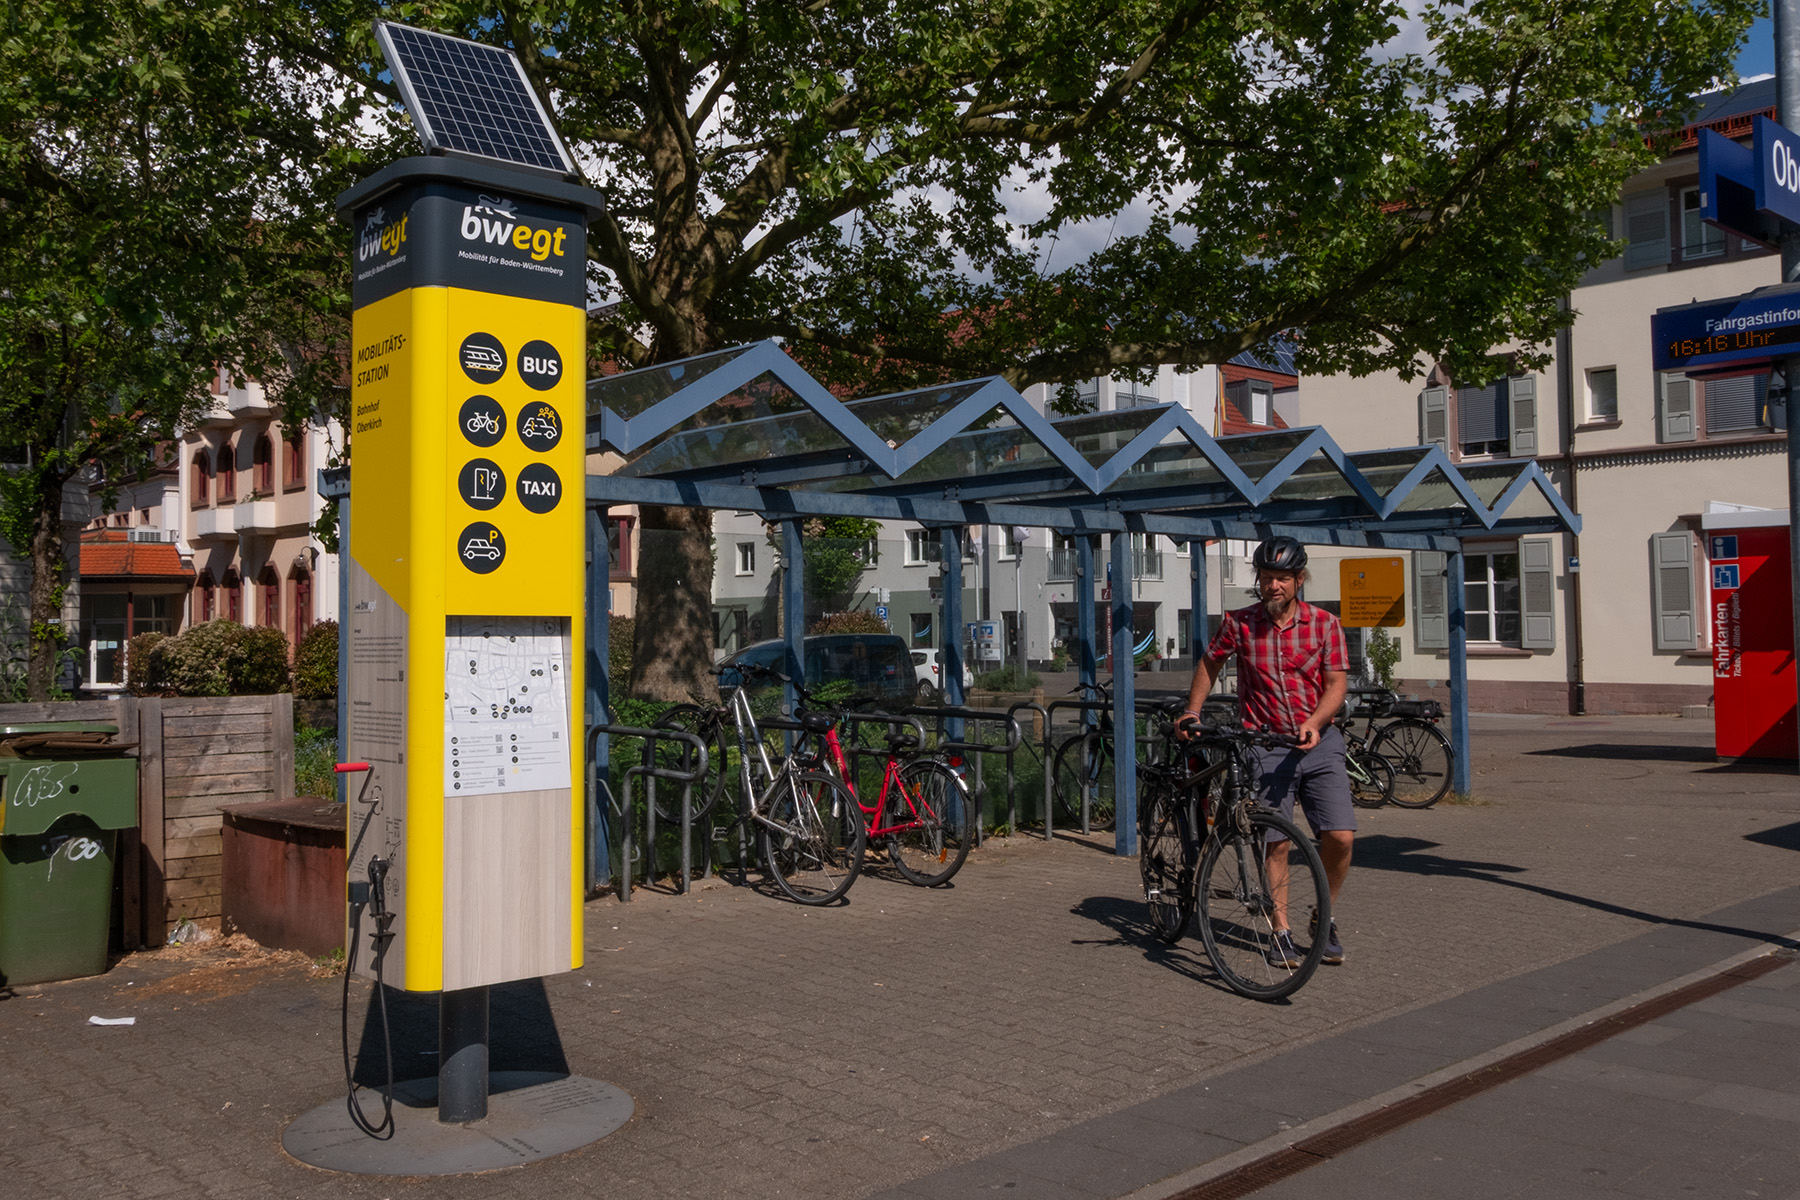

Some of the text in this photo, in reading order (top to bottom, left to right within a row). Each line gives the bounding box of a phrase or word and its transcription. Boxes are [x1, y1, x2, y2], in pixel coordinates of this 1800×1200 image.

[1773, 139, 1800, 193] Ob
[360, 211, 408, 262] bwegt
[461, 206, 567, 261] bwegt
[458, 250, 564, 276] Mobilität für Baden-Württemberg
[357, 334, 406, 364] MOBILITÄTS-
[1670, 331, 1775, 357] 16:16 Uhr
[357, 363, 389, 387] STATION
[523, 356, 558, 376] BUS
[357, 400, 380, 416] Bahnhof
[357, 417, 382, 433] Oberkirch
[522, 480, 556, 497] TAXI
[490, 530, 498, 543] P
[1715, 602, 1730, 678] Fahrkarten
